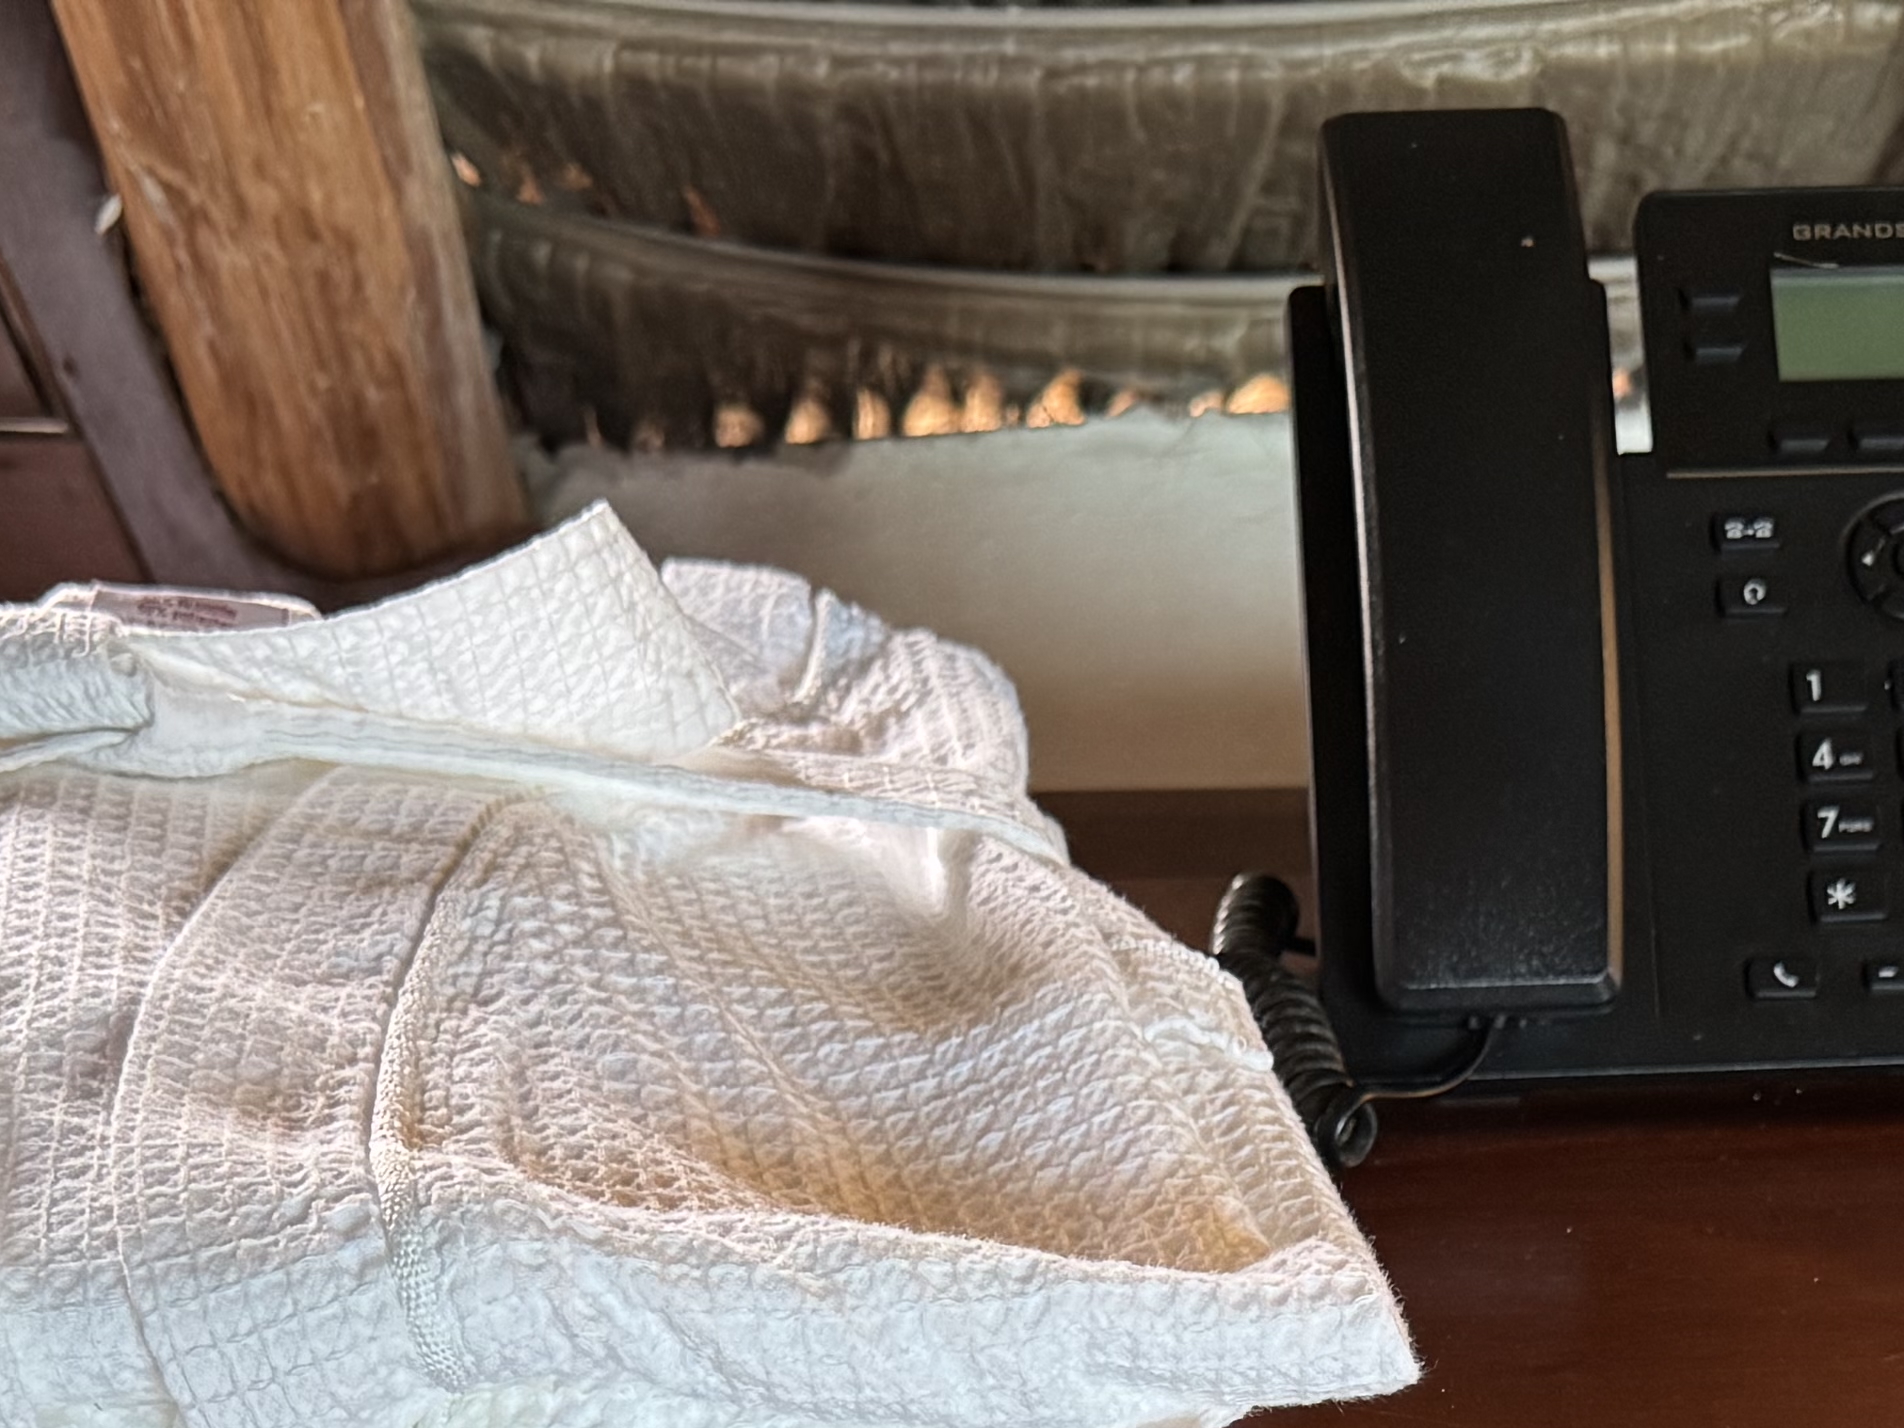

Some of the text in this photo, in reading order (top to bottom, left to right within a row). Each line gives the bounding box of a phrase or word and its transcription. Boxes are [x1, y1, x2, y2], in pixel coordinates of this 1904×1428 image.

[1805, 668, 1823, 701] 1
[1811, 736, 1835, 770] 4
[1817, 804, 1840, 838] 7
